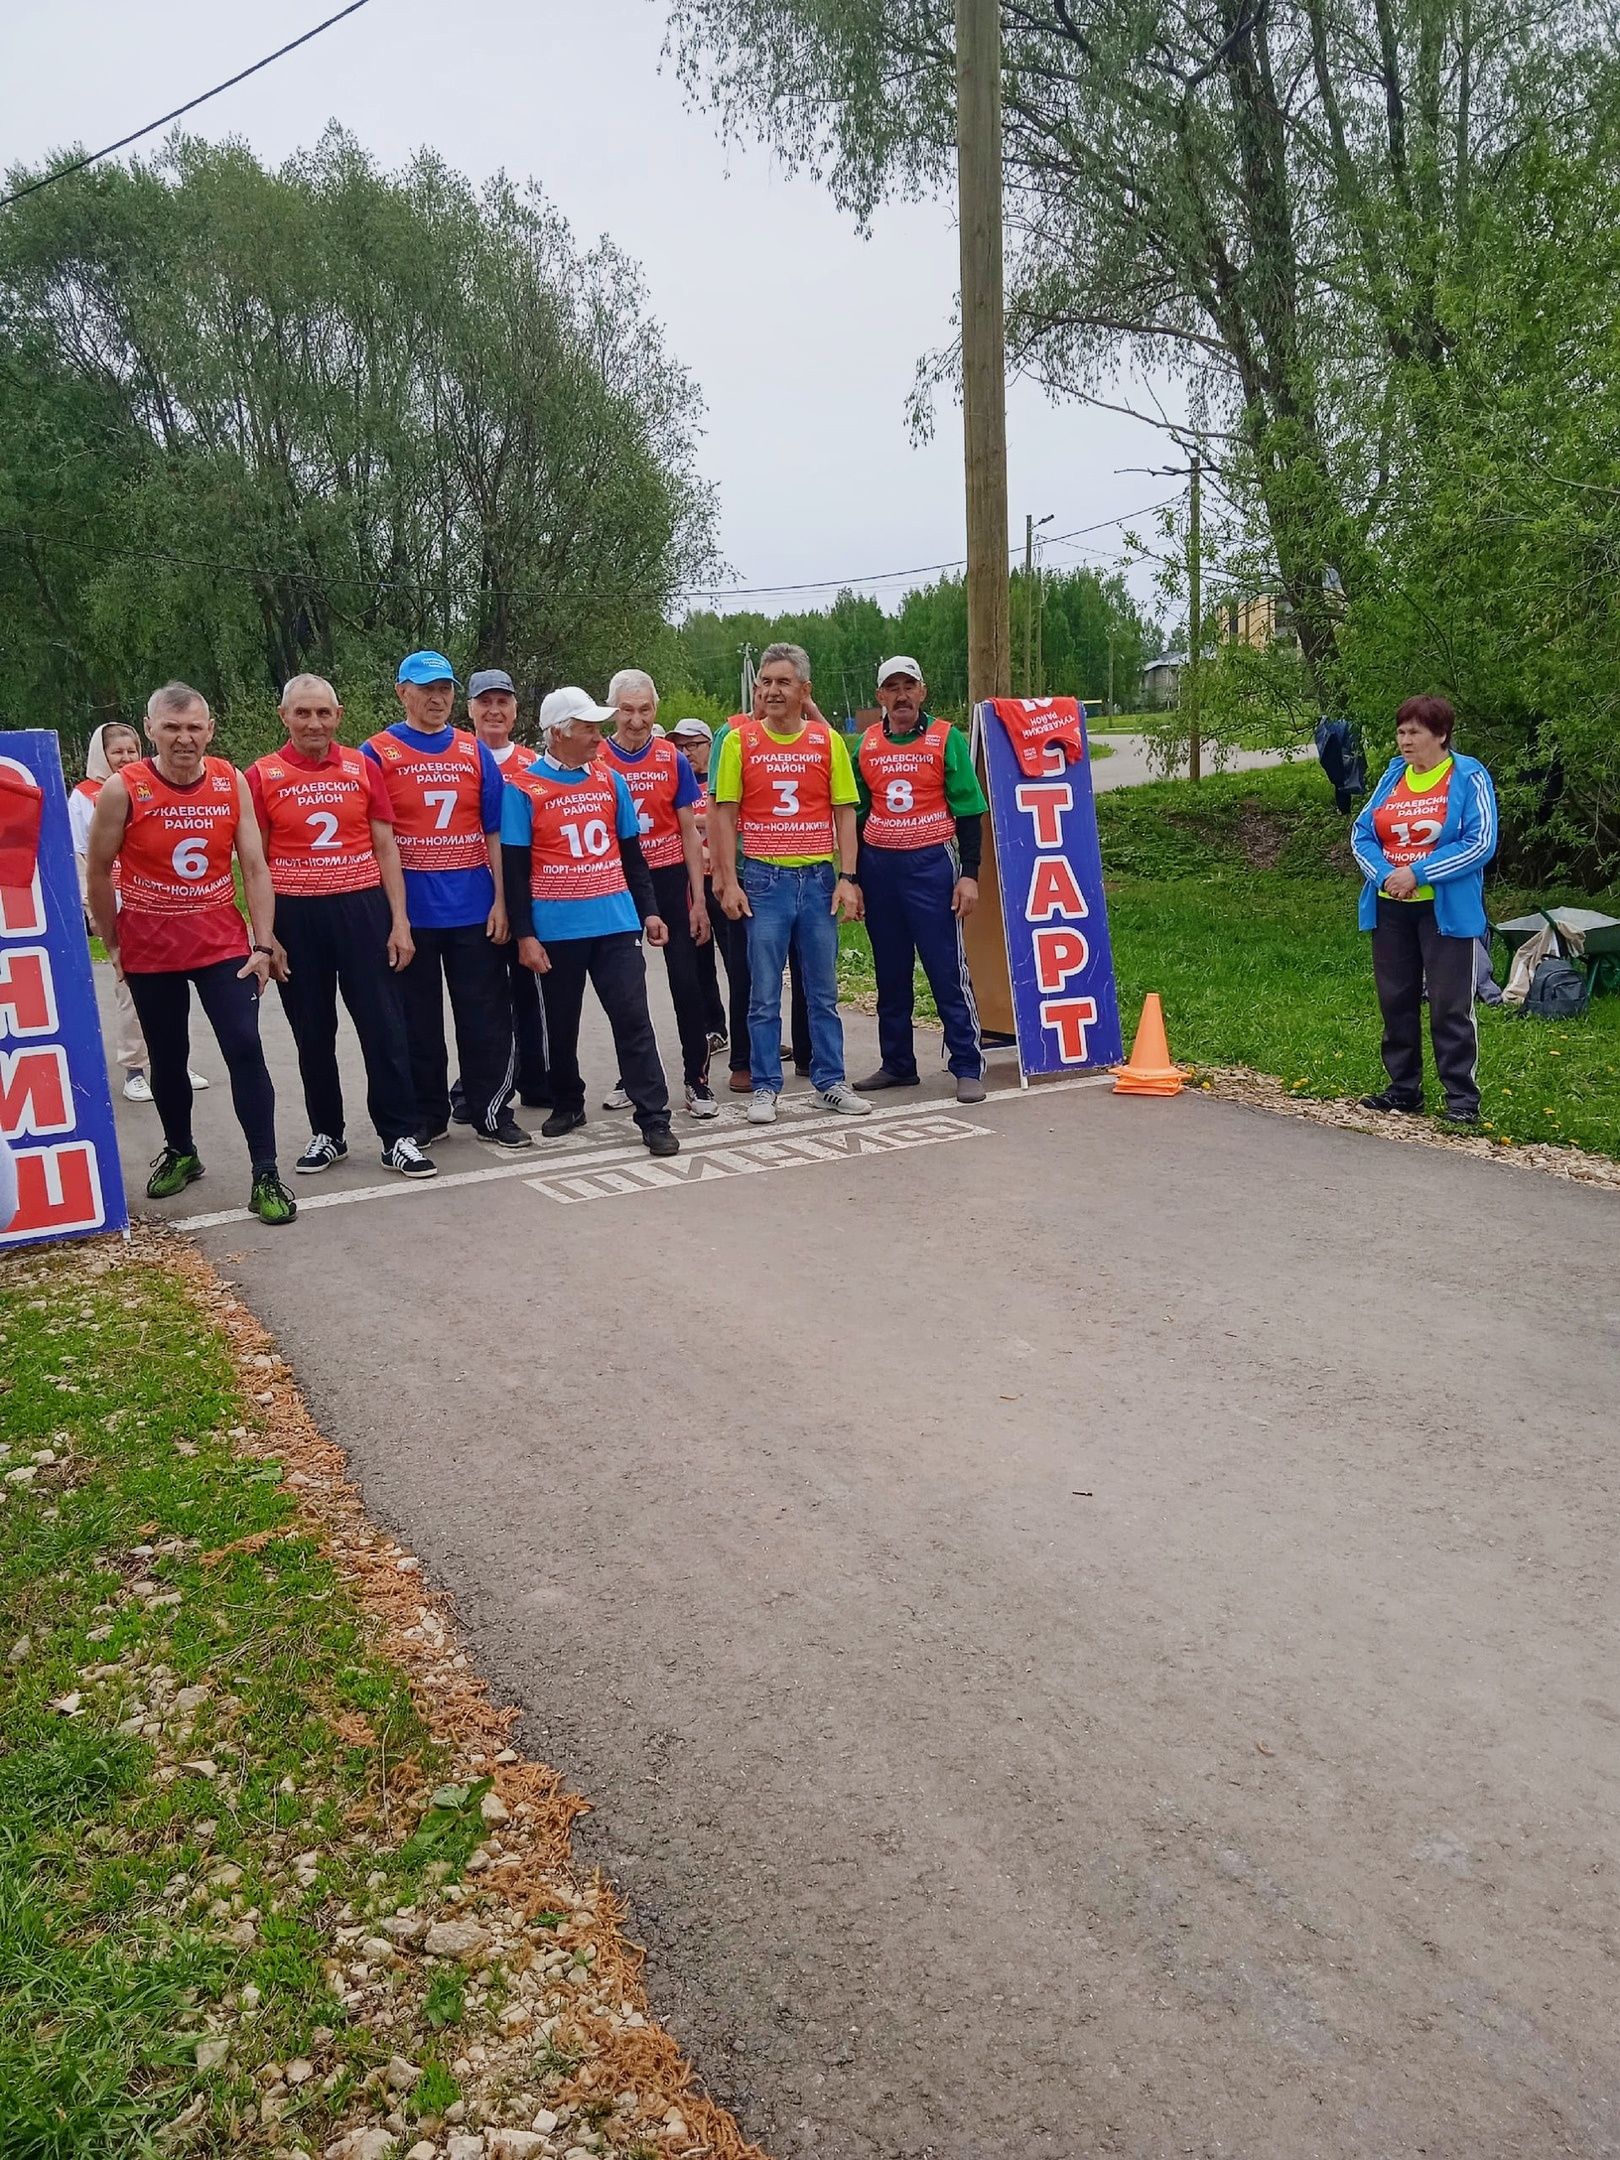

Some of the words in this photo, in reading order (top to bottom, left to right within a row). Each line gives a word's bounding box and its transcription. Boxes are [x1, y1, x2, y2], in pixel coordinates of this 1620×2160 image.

[1030, 711, 1058, 727] РАЙОН
[750, 753, 822, 764] ТУКАЕВСКИЙ
[869, 753, 934, 767] ТУКАЕВСКИЙ
[396, 762, 474, 776] ТУКАЕВСКИЙ
[766, 761, 806, 773] РАЙОН
[882, 762, 918, 774] РАЙОН
[416, 771, 461, 785] РАЙОН
[621, 770, 669, 782] ЕВСКИЙ
[278, 780, 360, 799] ТУКАЕВСКИЙ
[627, 781, 654, 791] ЙОН
[298, 791, 344, 807] РАЙОН
[544, 791, 614, 810] ТУКАЕВСКИЙ
[772, 780, 800, 816] 3
[886, 779, 914, 813] 8
[1385, 795, 1448, 811] ТУКАЕВСКИ
[423, 790, 458, 830] 7
[562, 803, 602, 817] РАЙОН
[633, 798, 655, 835] 4
[1397, 805, 1440, 818] РАЙОН
[164, 817, 214, 830] РАЙОН
[305, 811, 343, 850] 2
[395, 835, 418, 846] ПОРТ
[425, 835, 465, 846] НОРМА
[559, 819, 610, 858] 10
[1390, 819, 1443, 848] 12
[172, 836, 209, 880] 6
[1394, 851, 1428, 862] НОРМ
[539, 1118, 974, 1201] ФИНИШ
